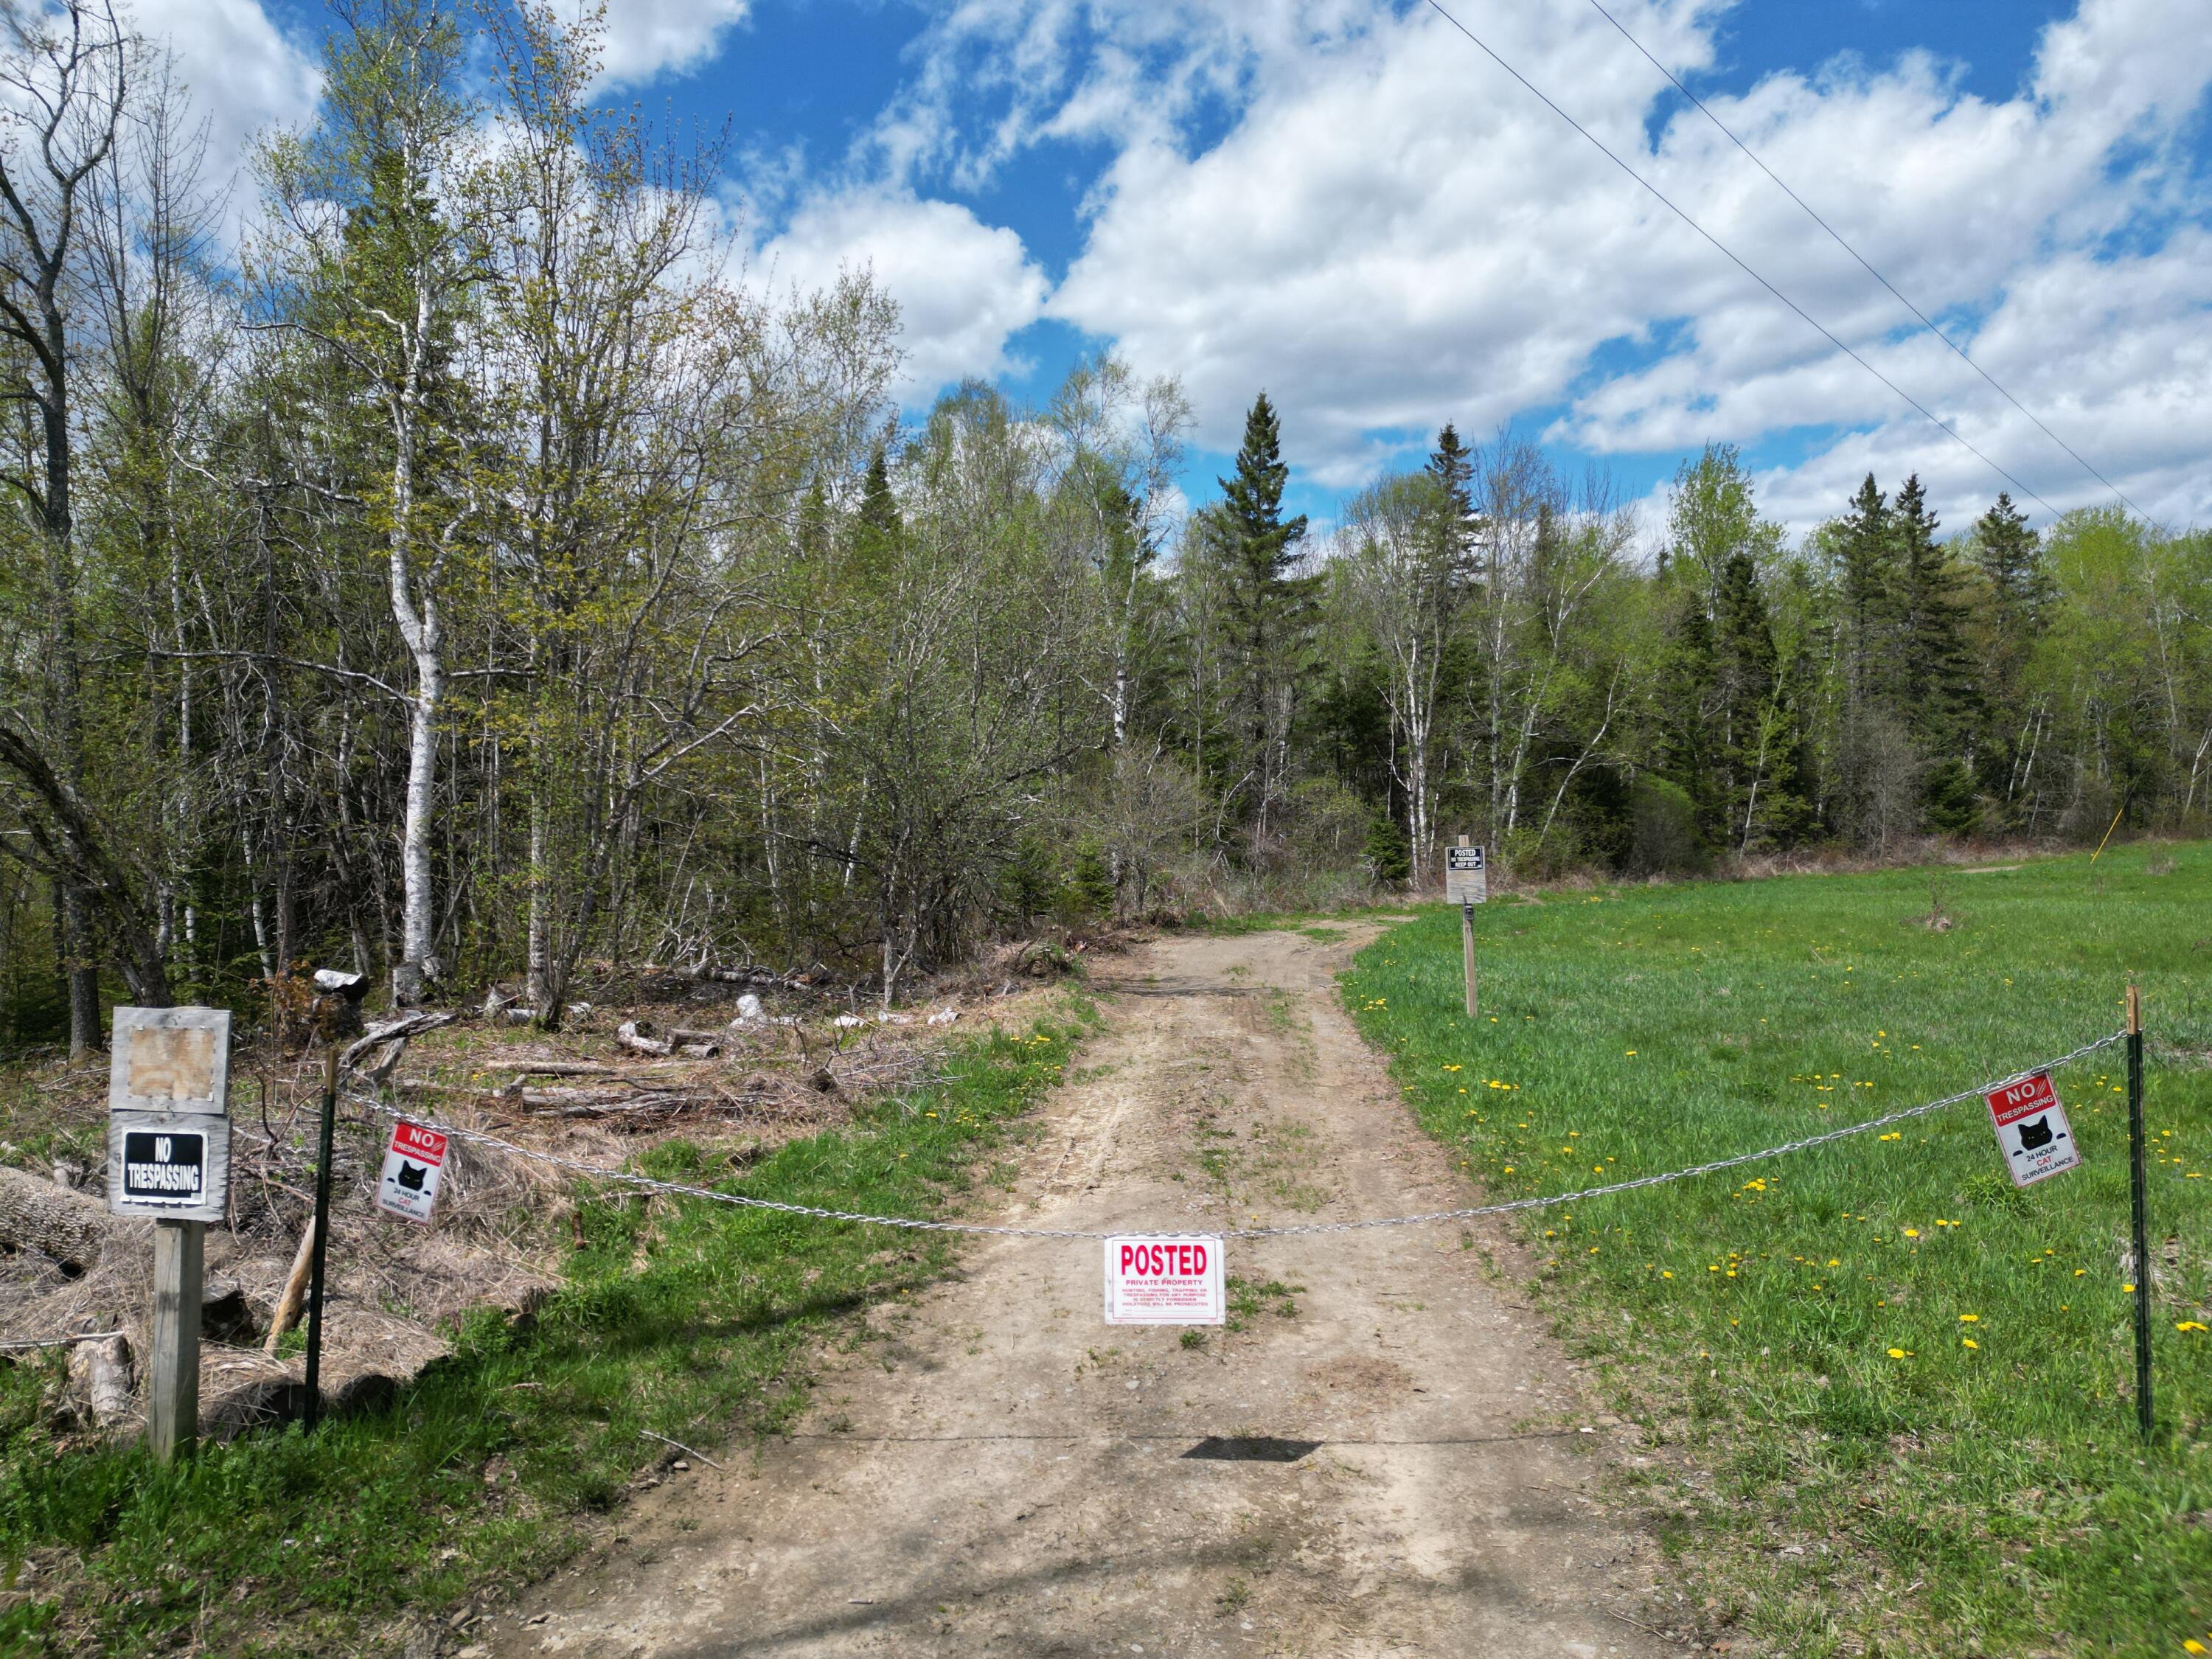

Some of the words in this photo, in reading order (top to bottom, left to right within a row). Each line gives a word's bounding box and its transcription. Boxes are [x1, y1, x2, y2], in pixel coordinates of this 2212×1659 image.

[2006, 1083, 2036, 1105] NO
[1997, 1095, 2053, 1122] TRESPASSING
[409, 1129, 434, 1147] NO
[155, 1137, 171, 1163] NO
[394, 1141, 441, 1163] TRESPASSING
[2026, 1154, 2035, 1162] 24
[2036, 1145, 2058, 1159] HOUR
[2037, 1156, 2052, 1166] CAT
[128, 1163, 199, 1191] TRESPASSING
[2022, 1156, 2073, 1180] SURVEILLANCE
[398, 1197, 412, 1206] CAT
[401, 1191, 420, 1202] HOUR
[382, 1199, 425, 1218] SURVEILLANCE
[1121, 1245, 1207, 1276] POSTED
